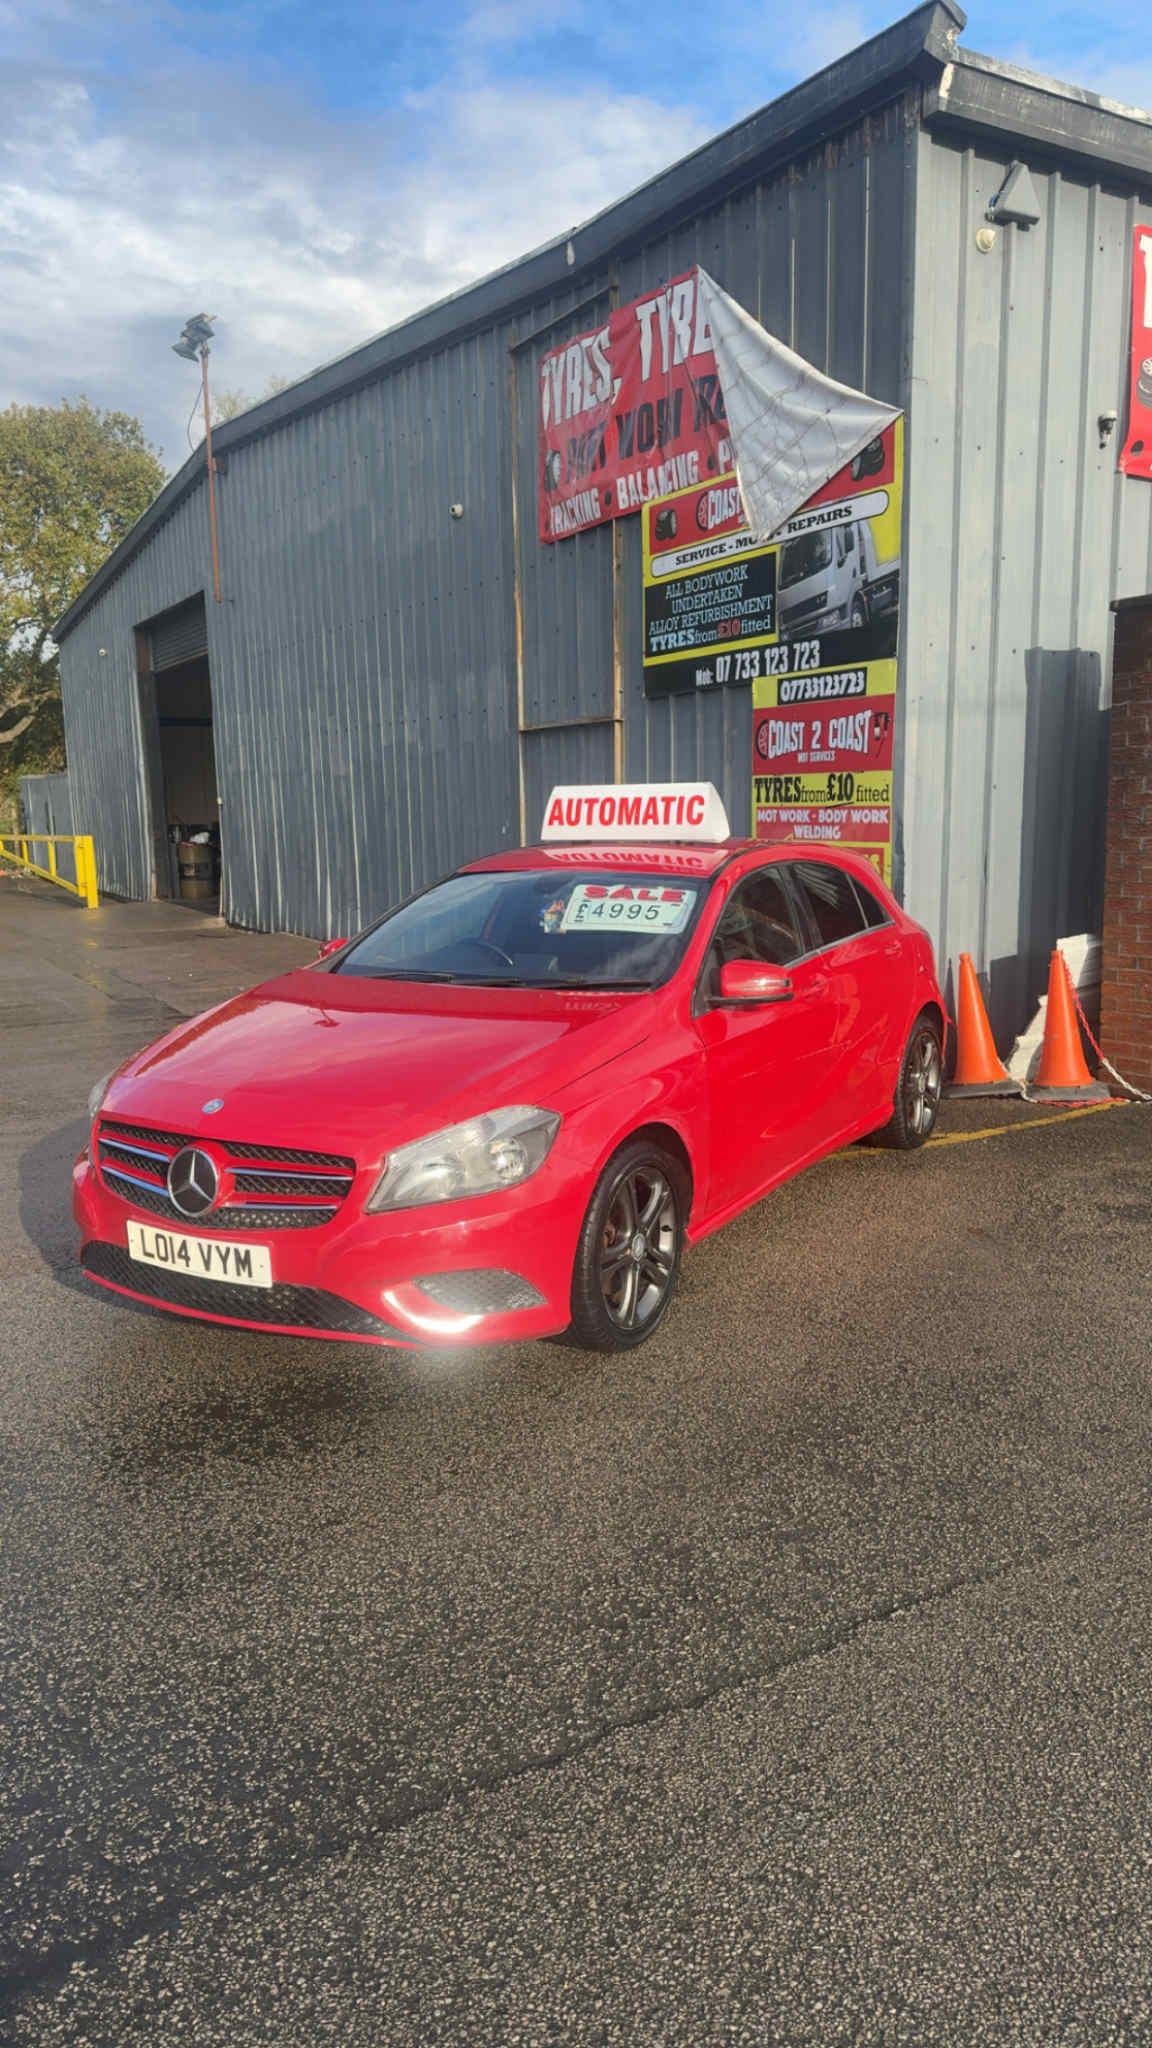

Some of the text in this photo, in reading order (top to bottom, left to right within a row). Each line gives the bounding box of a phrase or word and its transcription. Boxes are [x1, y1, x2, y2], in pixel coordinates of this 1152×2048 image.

[551, 487, 601, 536] TRACKING
[616, 450, 699, 510] BALANCING
[675, 542, 727, 566] SERVICE
[787, 505, 853, 534] REPAIRS
[665, 564, 748, 599] ALL BODYWORK
[649, 594, 773, 636] ALLOY REFURBISHMENT
[671, 584, 743, 613] UNDERTAKEN
[650, 628, 695, 652] TYRES
[694, 629, 717, 642] from
[741, 615, 771, 634] fitted
[715, 655, 731, 683] 07
[735, 650, 760, 680] 733
[764, 645, 788, 676] 123
[793, 640, 820, 672] 723
[780, 671, 865, 702] 07733123723
[768, 710, 872, 760] COAST 2 COAST
[754, 772, 889, 804] TYRES from £10 fitted
[547, 795, 705, 827] AUTOMATIC
[757, 809, 777, 823] MOT
[779, 809, 810, 823] WORK
[818, 809, 847, 823] BODY
[850, 808, 888, 823] WORK
[793, 824, 841, 840] WELDING
[583, 886, 686, 903] SALE
[574, 903, 661, 922] £4995
[140, 1228, 253, 1278] LO14 VYM
